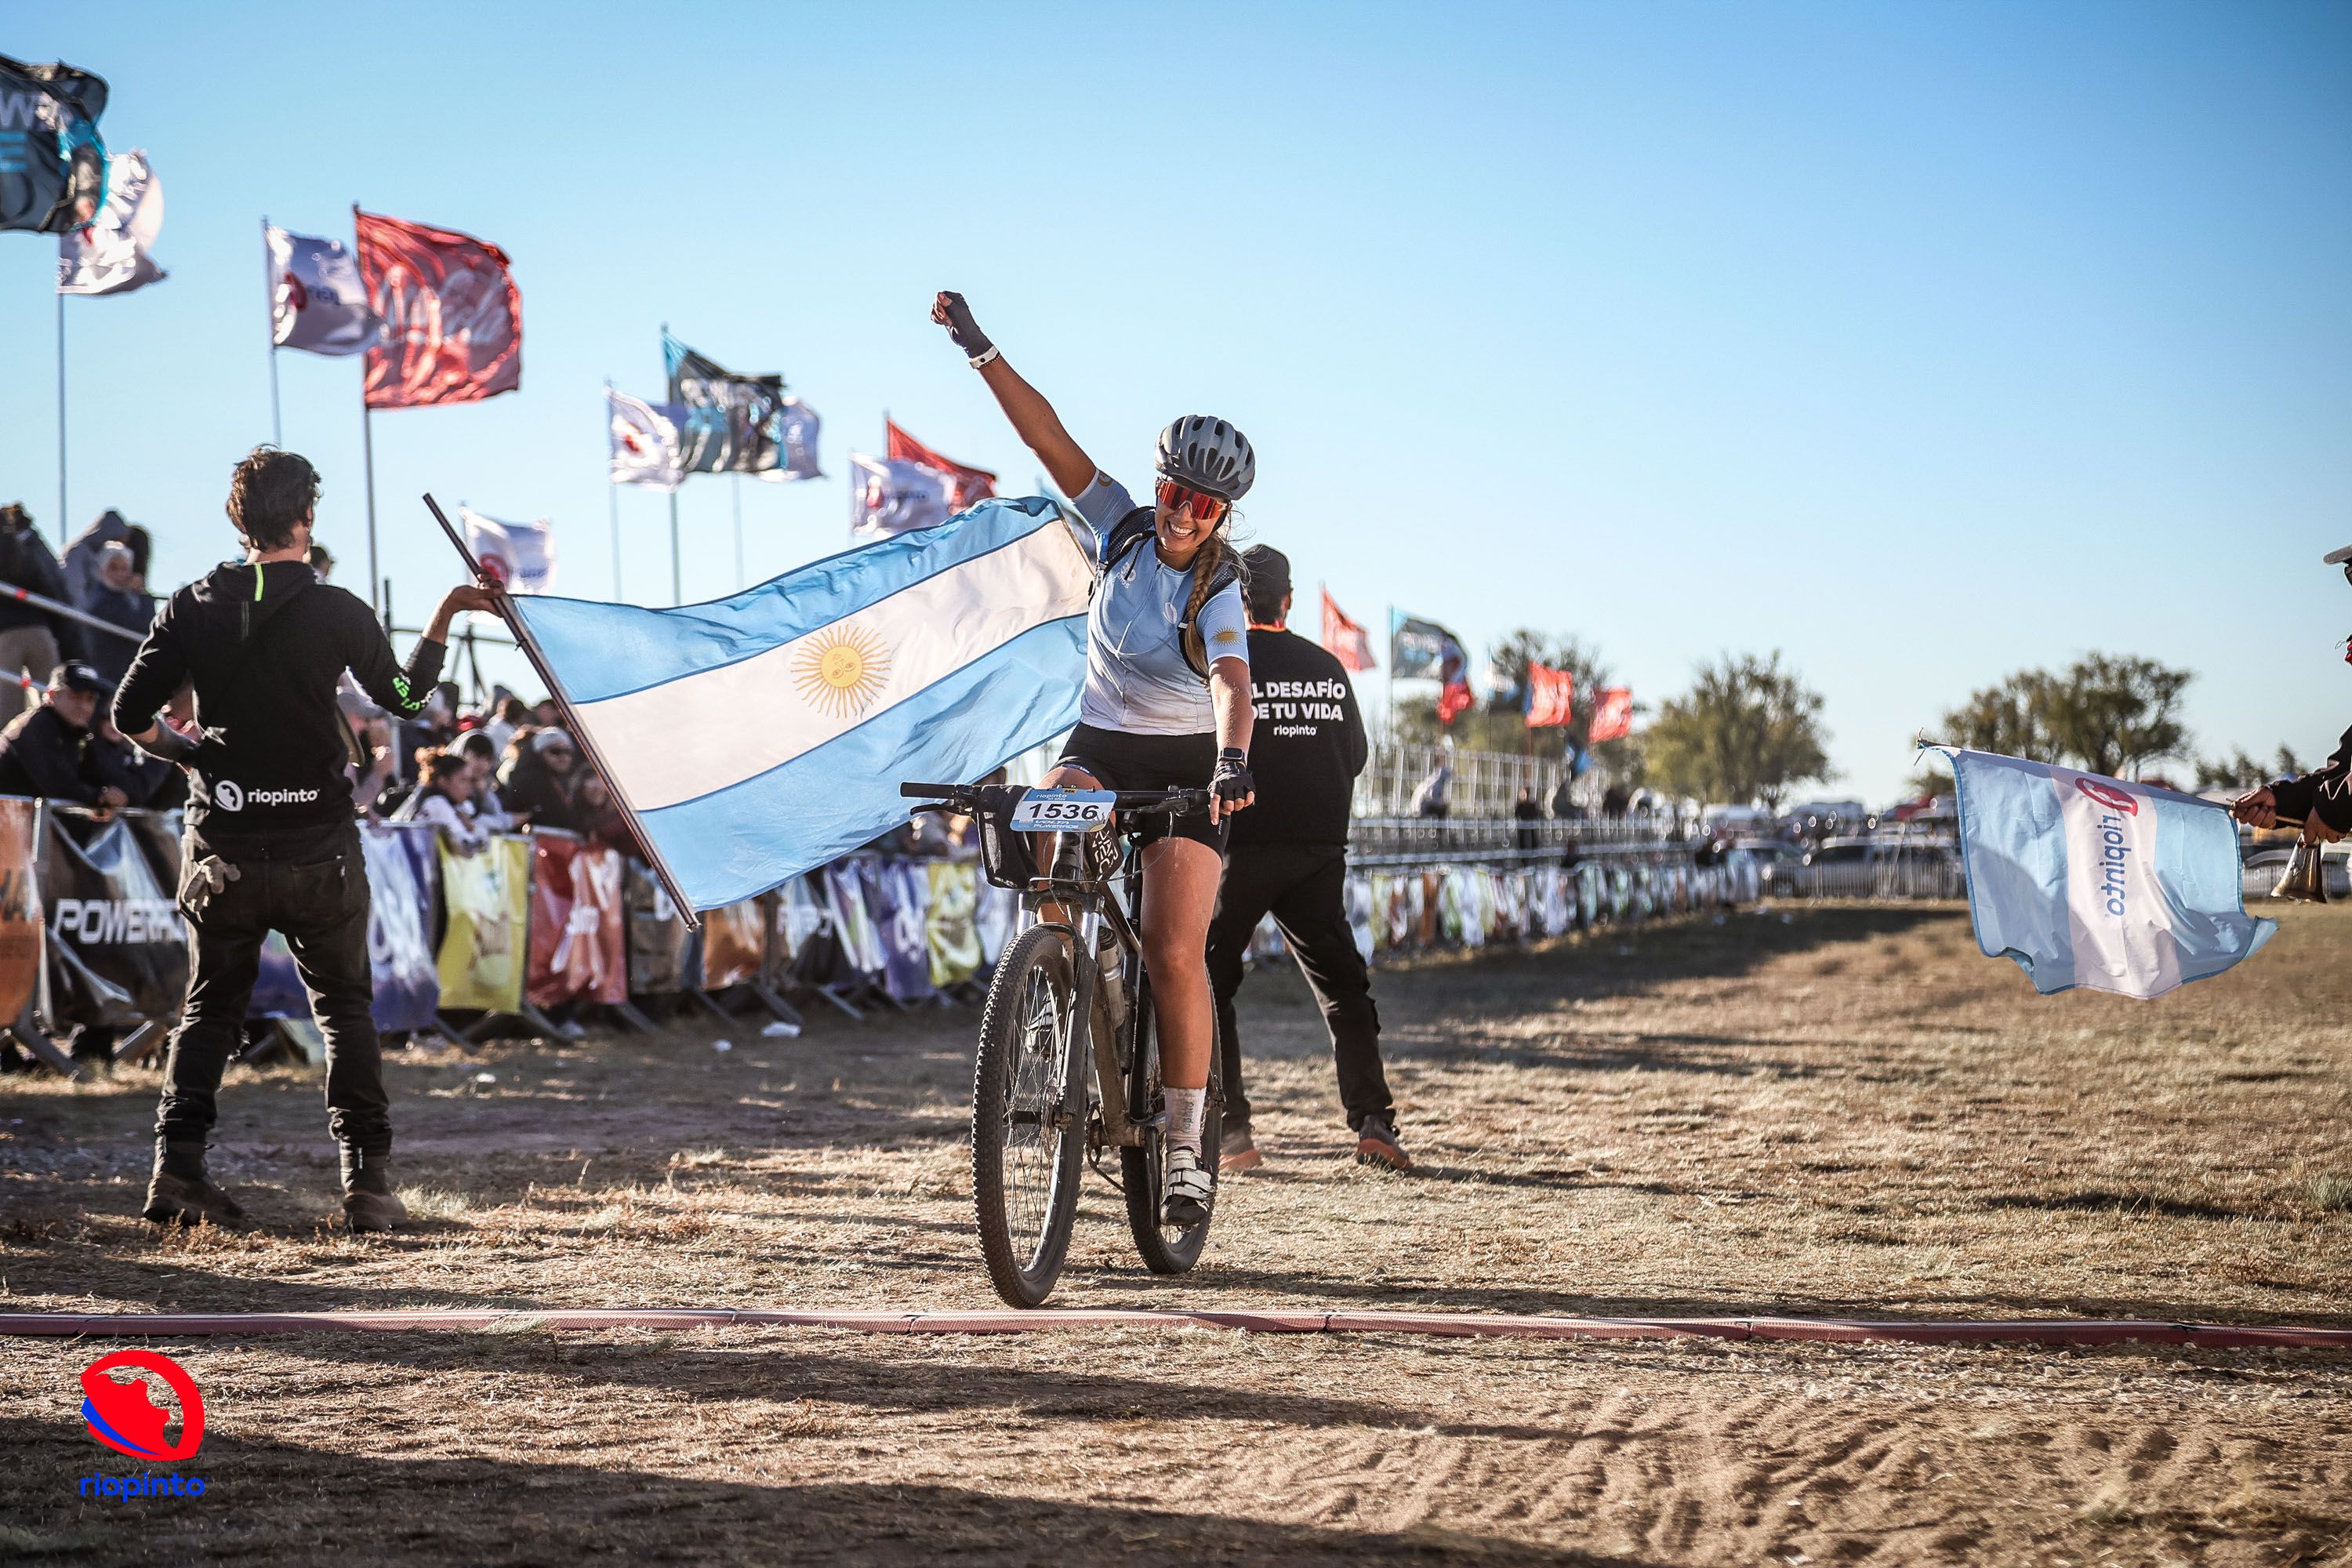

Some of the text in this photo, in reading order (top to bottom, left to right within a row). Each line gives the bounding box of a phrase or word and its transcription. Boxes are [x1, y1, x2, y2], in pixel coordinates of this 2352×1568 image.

[1251, 678, 1346, 699] L DESAFÍO
[1272, 703, 1297, 720] TU
[1301, 703, 1344, 721] VIDA
[1273, 724, 1317, 737] riopinto
[248, 789, 318, 806] riopinto
[1029, 803, 1099, 820] 1536
